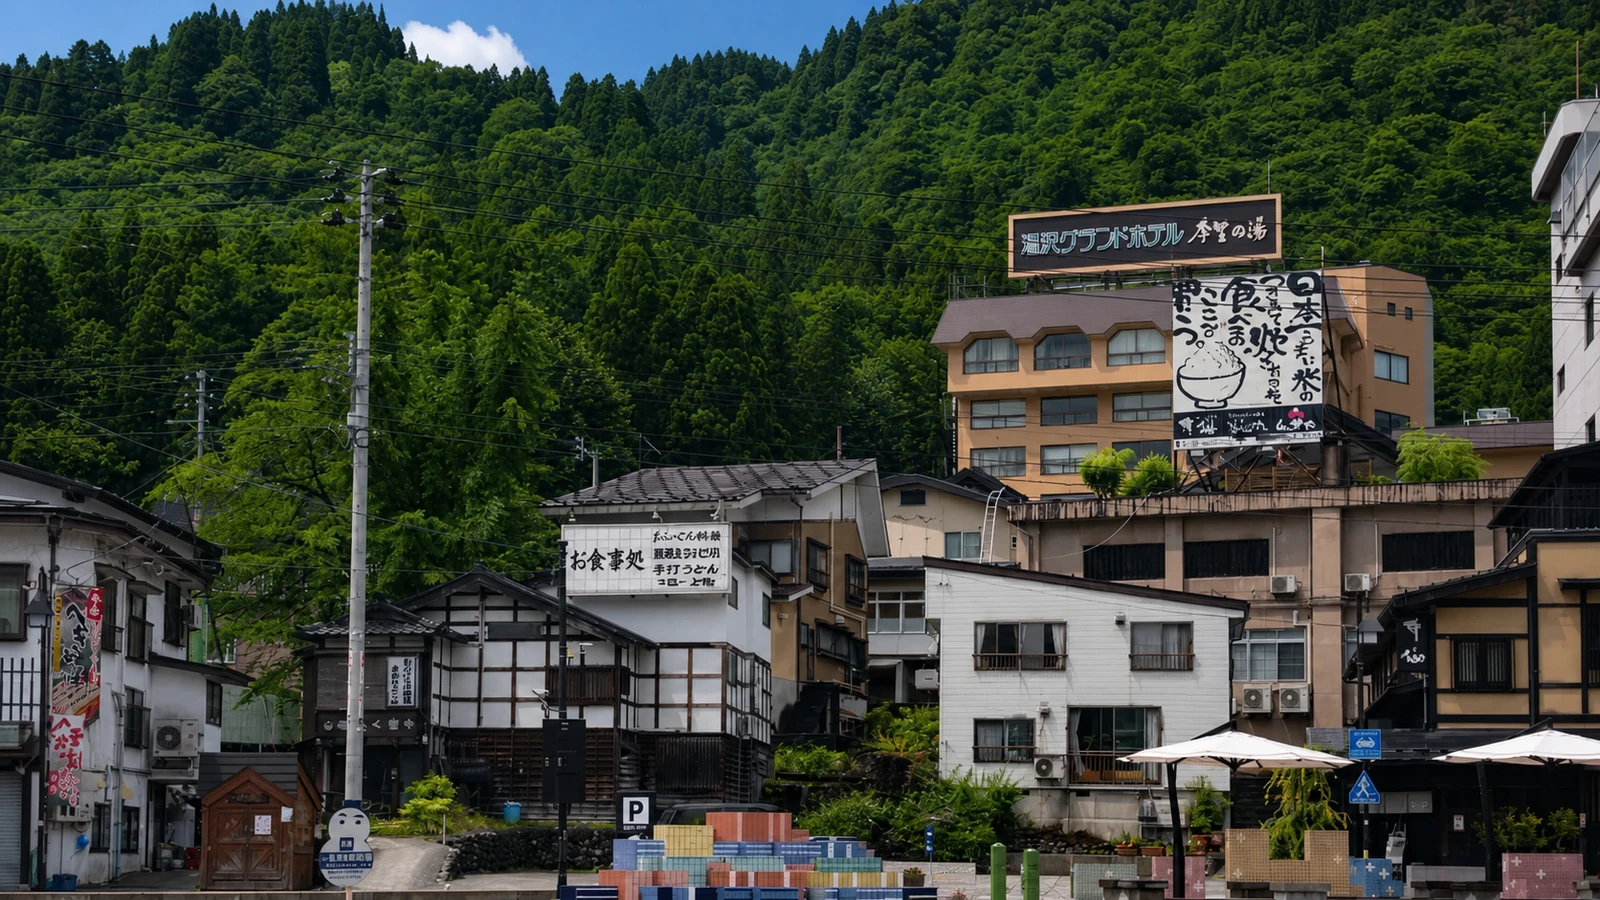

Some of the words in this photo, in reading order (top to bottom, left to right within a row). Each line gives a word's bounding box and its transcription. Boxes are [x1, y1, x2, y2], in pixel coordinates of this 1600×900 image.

[570, 547, 645, 572] お食事処
[652, 563, 719, 576] 手打うどん
[629, 800, 644, 822] P
